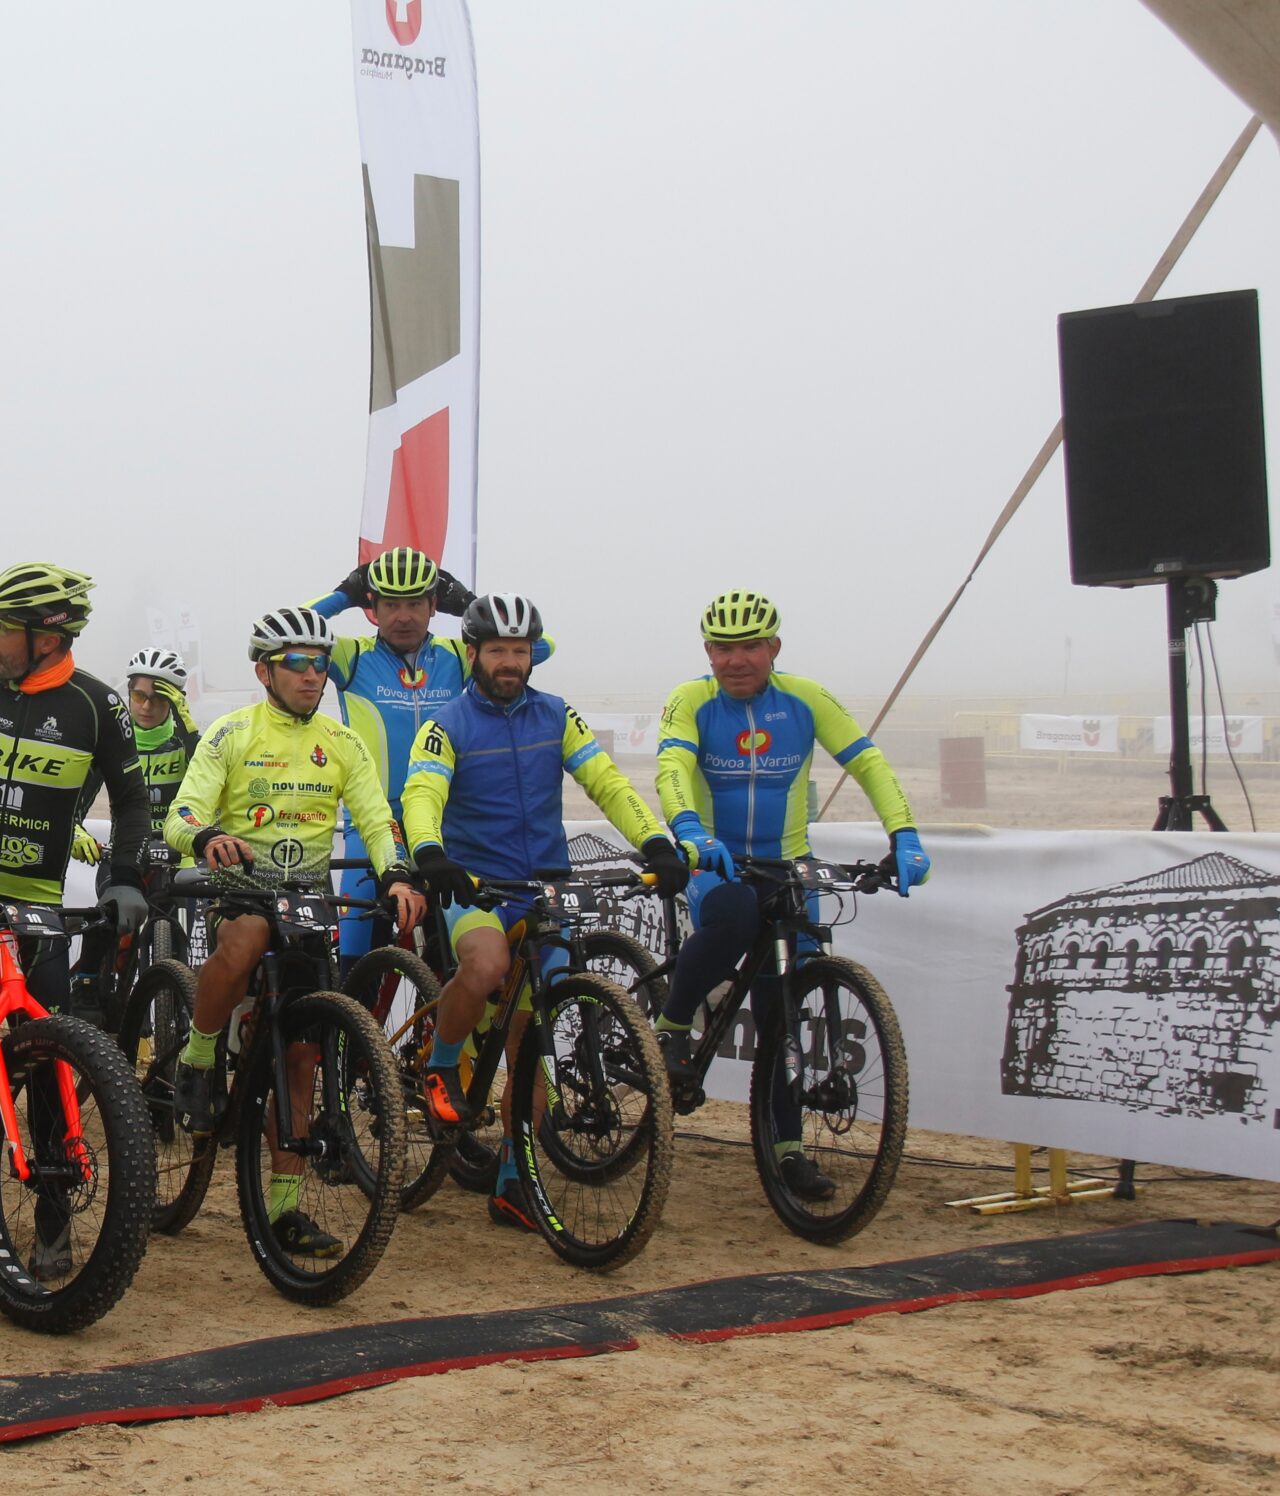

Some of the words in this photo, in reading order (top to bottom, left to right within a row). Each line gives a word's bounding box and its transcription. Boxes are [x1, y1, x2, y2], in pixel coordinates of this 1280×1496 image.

[419, 688, 452, 699] Varzim
[704, 753, 745, 768] Póvoa
[758, 754, 800, 767] Varzim
[561, 893, 579, 907] 20
[296, 906, 314, 920] 19
